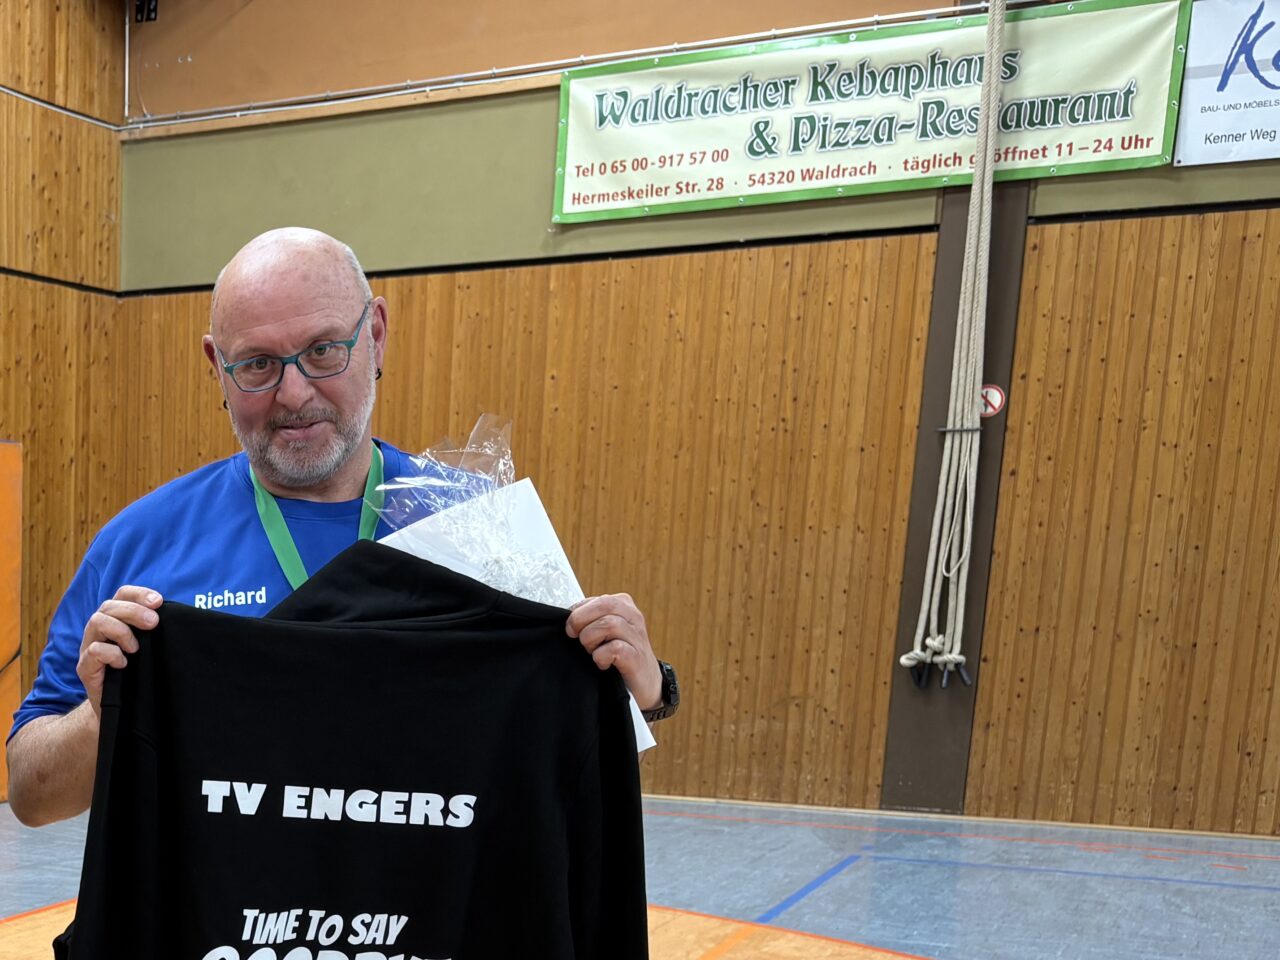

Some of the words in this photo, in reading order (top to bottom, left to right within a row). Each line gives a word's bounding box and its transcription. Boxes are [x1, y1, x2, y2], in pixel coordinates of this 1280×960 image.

[595, 74, 797, 128] Waldracher
[747, 120, 778, 157] &
[791, 80, 1135, 153] Pizza-Resaurant
[1200, 105, 1221, 114] BAU-
[1223, 102, 1242, 111] UND
[1204, 131, 1246, 145] Kenner
[1250, 128, 1277, 142] Weg
[572, 184, 670, 205] Hermeskeiler
[675, 181, 701, 195] Str.
[707, 177, 724, 192] 28
[748, 170, 795, 187] 54320
[801, 162, 877, 183] Waldrach
[902, 152, 962, 173] täglich
[1121, 134, 1154, 150] Uhr
[575, 163, 594, 178] Tel
[194, 586, 266, 609] Richard
[202, 779, 267, 815] TV
[282, 785, 477, 828] ENGERS
[242, 908, 303, 945] TIME
[305, 910, 343, 946] TO
[348, 913, 408, 945] SAY
